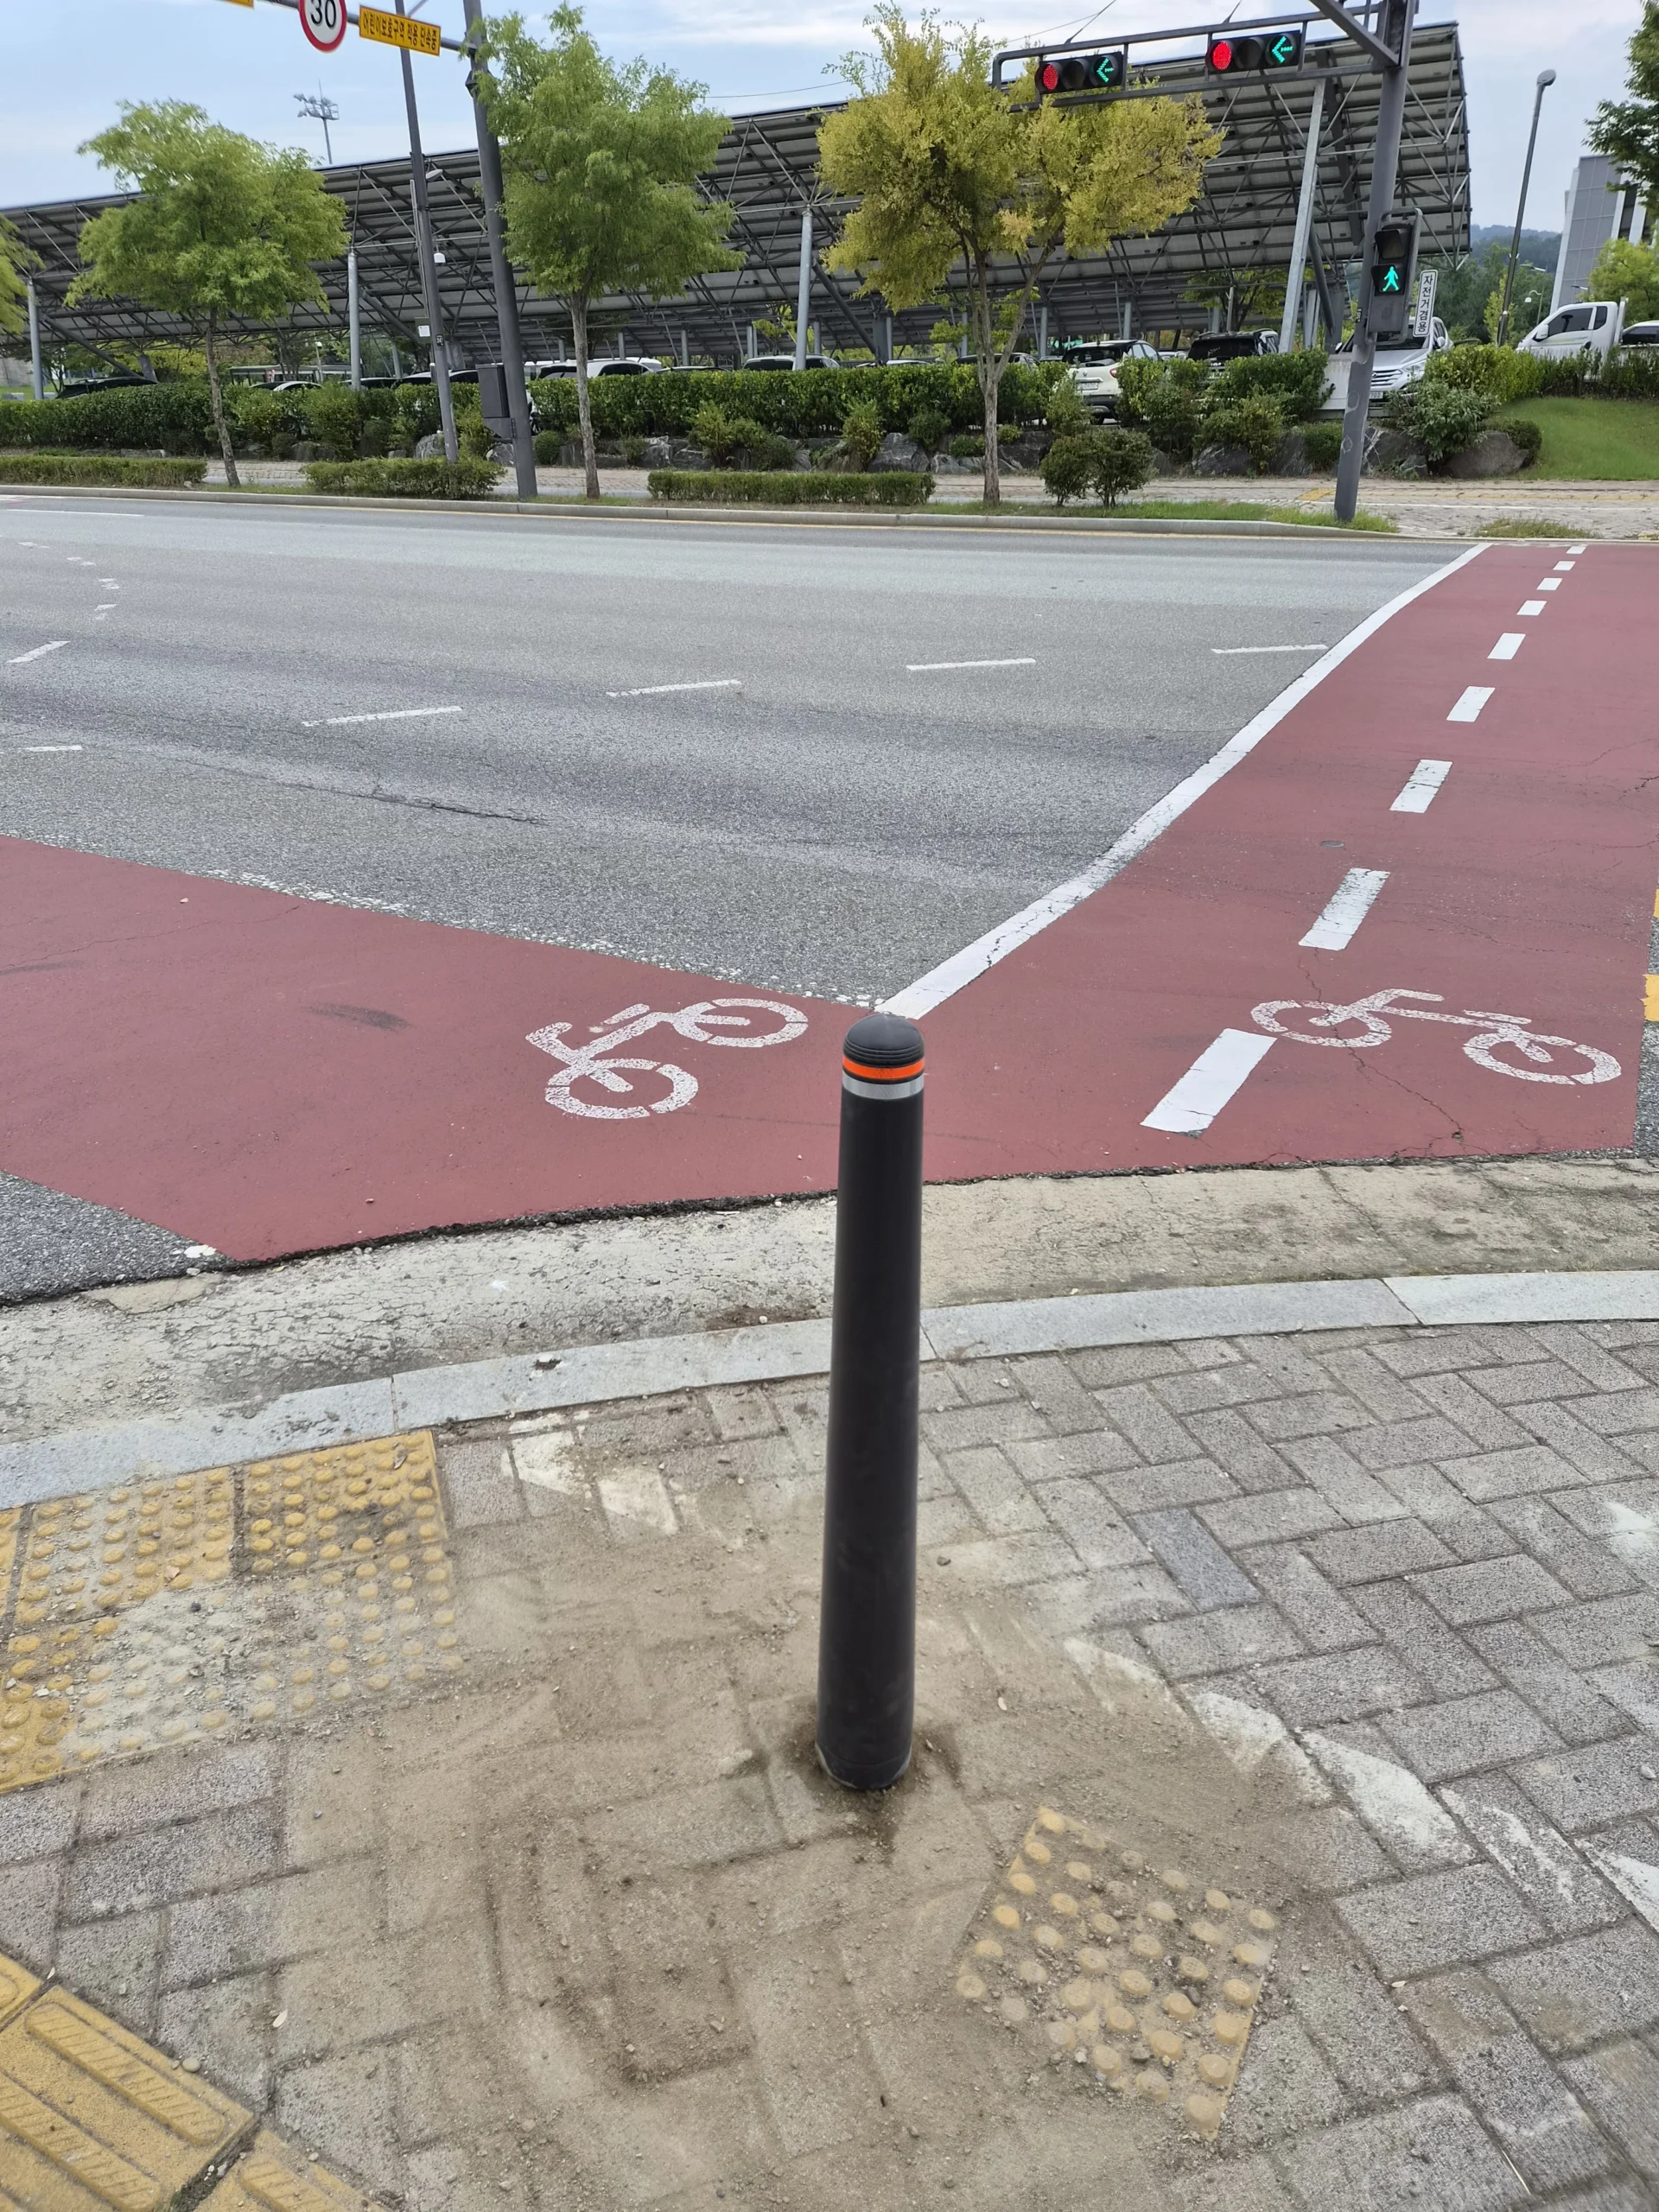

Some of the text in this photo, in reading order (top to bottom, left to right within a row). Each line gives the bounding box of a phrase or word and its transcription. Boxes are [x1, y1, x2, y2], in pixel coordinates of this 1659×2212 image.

[310, 0, 336, 28] 30
[363, 10, 404, 42] 어린이보호구역
[420, 26, 437, 51] 단속중
[1418, 275, 1433, 333] 자전거겸용
